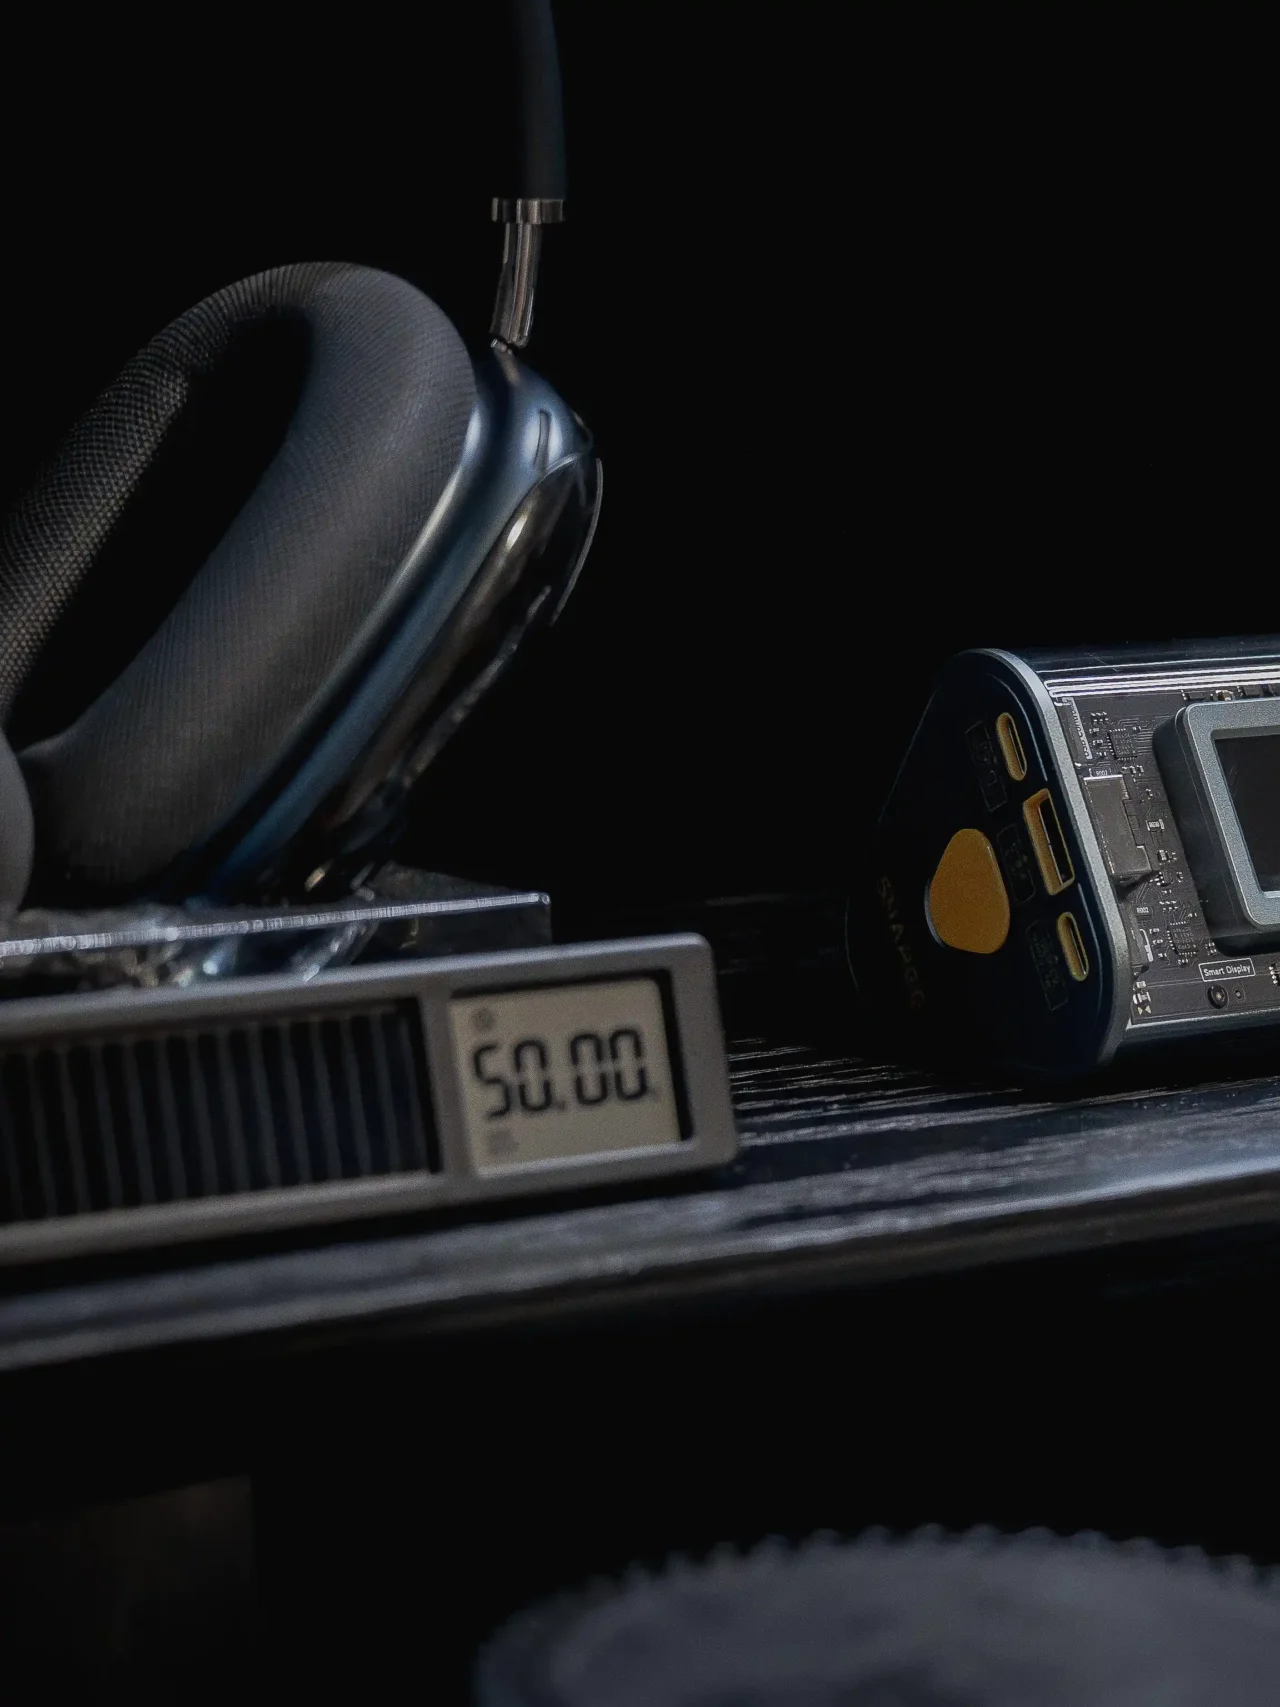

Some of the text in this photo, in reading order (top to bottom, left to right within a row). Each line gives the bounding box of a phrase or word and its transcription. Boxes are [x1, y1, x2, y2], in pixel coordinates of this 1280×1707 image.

[1203, 964, 1251, 977] Smart Display
[473, 1028, 648, 1121] 50.00
